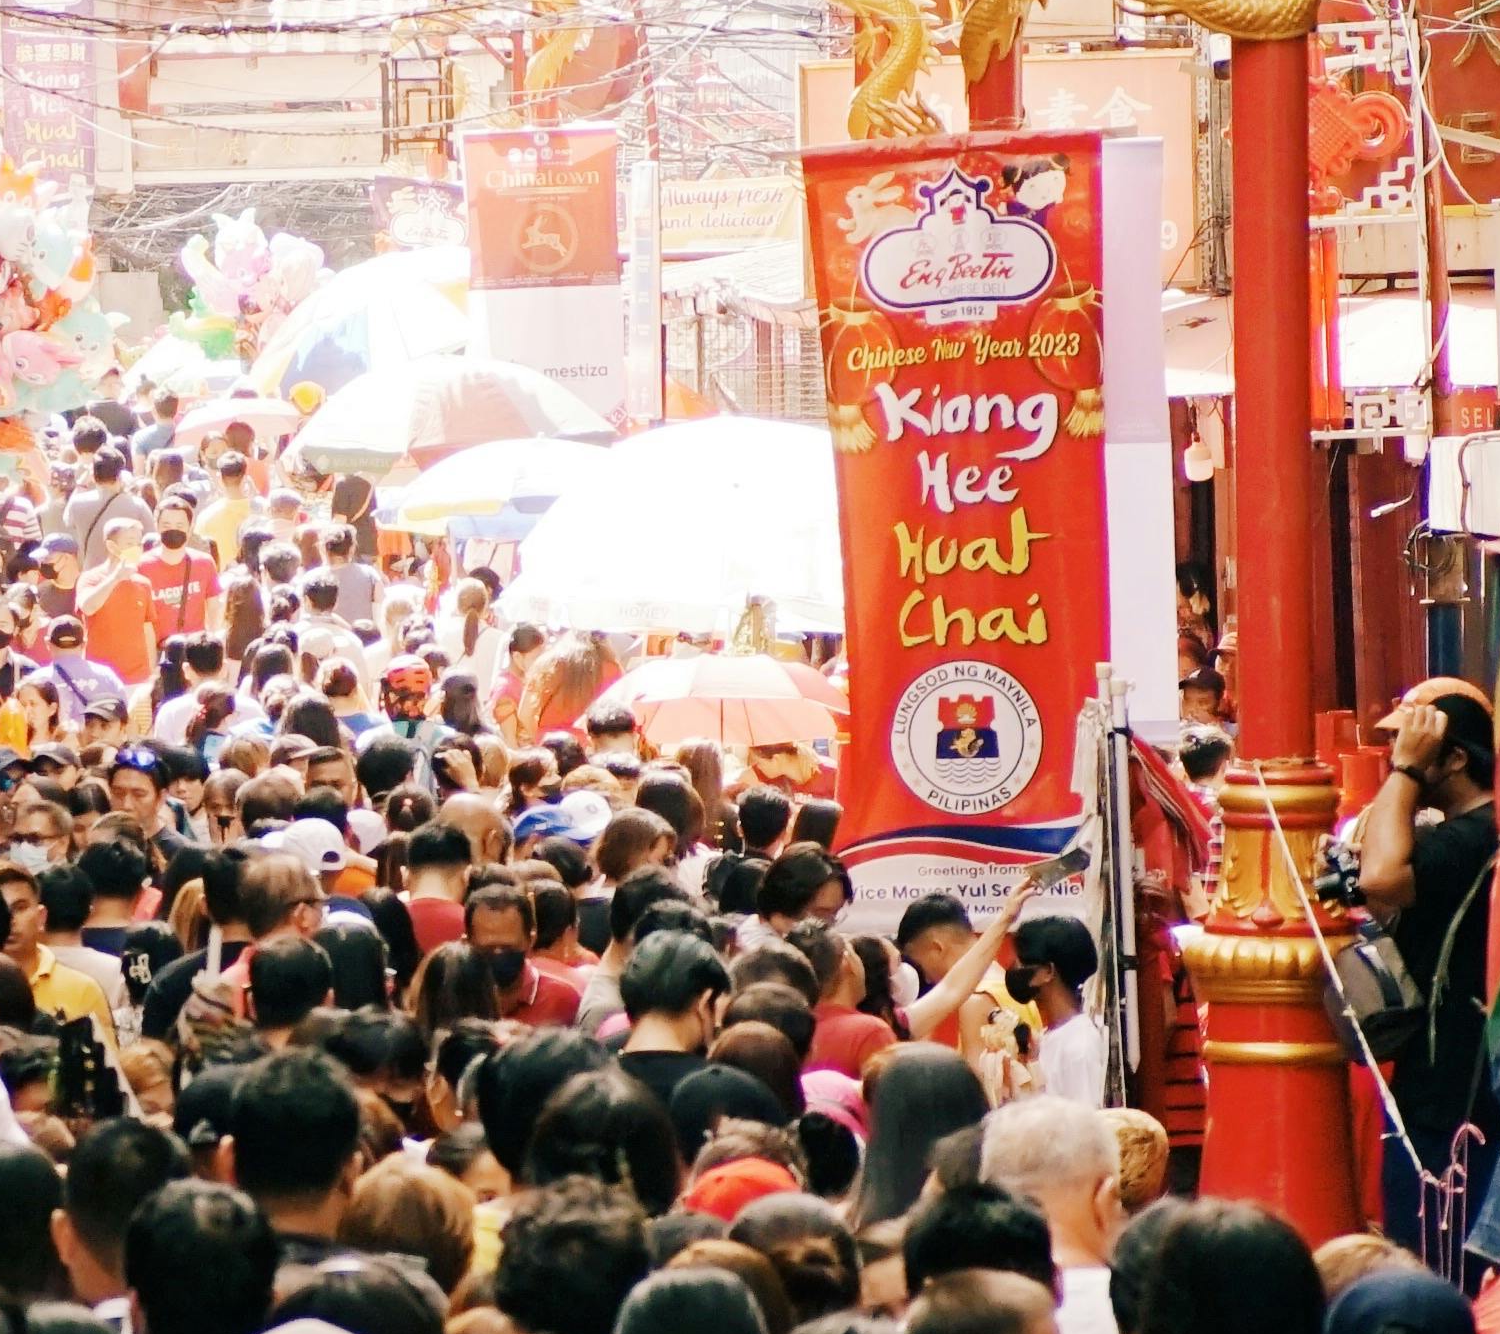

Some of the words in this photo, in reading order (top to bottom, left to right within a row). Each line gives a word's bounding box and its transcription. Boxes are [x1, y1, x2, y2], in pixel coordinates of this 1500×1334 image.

[484, 169, 601, 189] Chinatown
[960, 305, 986, 318] 1912
[847, 343, 927, 372] Chinese
[972, 335, 1025, 365] Year
[1027, 332, 1082, 359] 2023
[543, 362, 609, 378] mestiza
[917, 449, 1022, 515] Hee
[892, 515, 1052, 583] Huat
[896, 591, 1051, 648] Chai
[893, 667, 950, 735] LUNGSOD
[954, 664, 979, 679] NG
[983, 666, 1038, 729] MAYNILA
[926, 786, 1013, 813] PILIPINAS
[917, 865, 986, 879] Greetings
[957, 882, 987, 897] Yul
